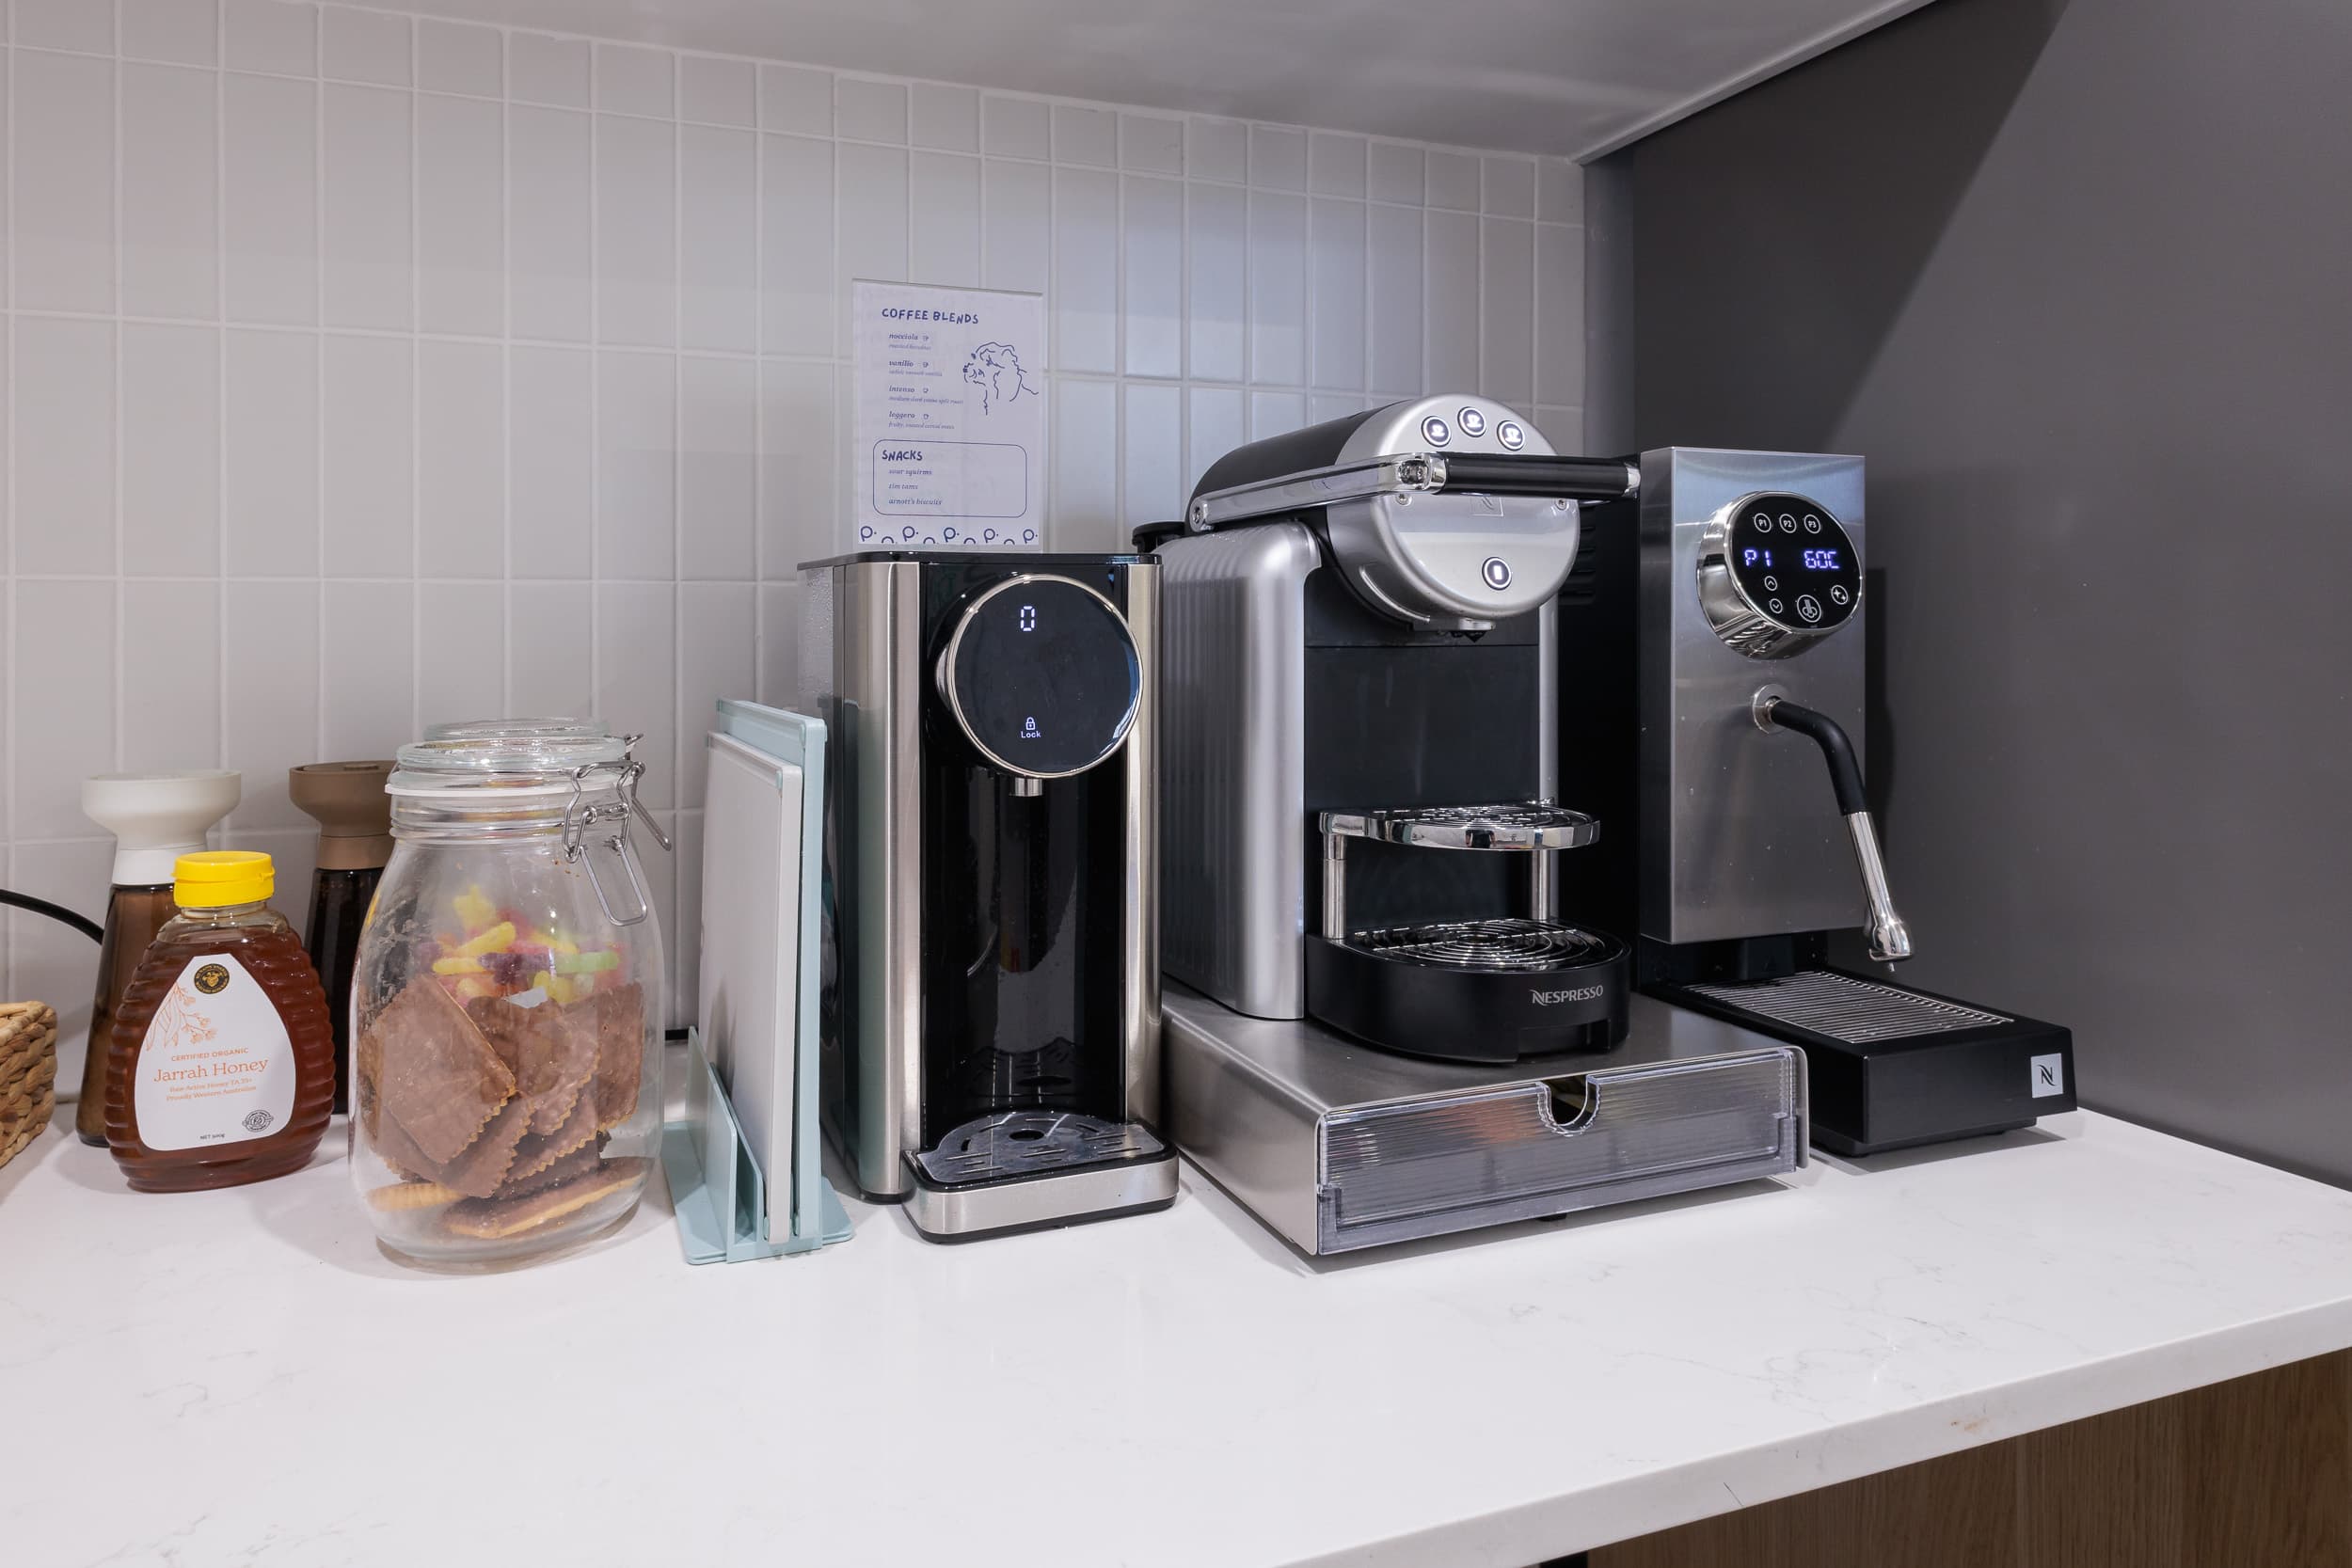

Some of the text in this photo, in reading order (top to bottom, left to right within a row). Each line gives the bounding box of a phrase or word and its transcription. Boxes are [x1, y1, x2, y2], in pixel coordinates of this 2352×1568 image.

[882, 309, 979, 325] COFFEE BLENDS
[888, 333, 919, 341] nocciola
[888, 410, 915, 420] leggero
[882, 450, 923, 462] SNACKS
[905, 468, 932, 477] squirms
[1020, 730, 1041, 738] Lock
[1529, 985, 1604, 1006] NESPRESSO
[170, 1047, 249, 1062] CERTIFIED ORGANIC
[153, 1059, 269, 1082] Jarrah Honey
